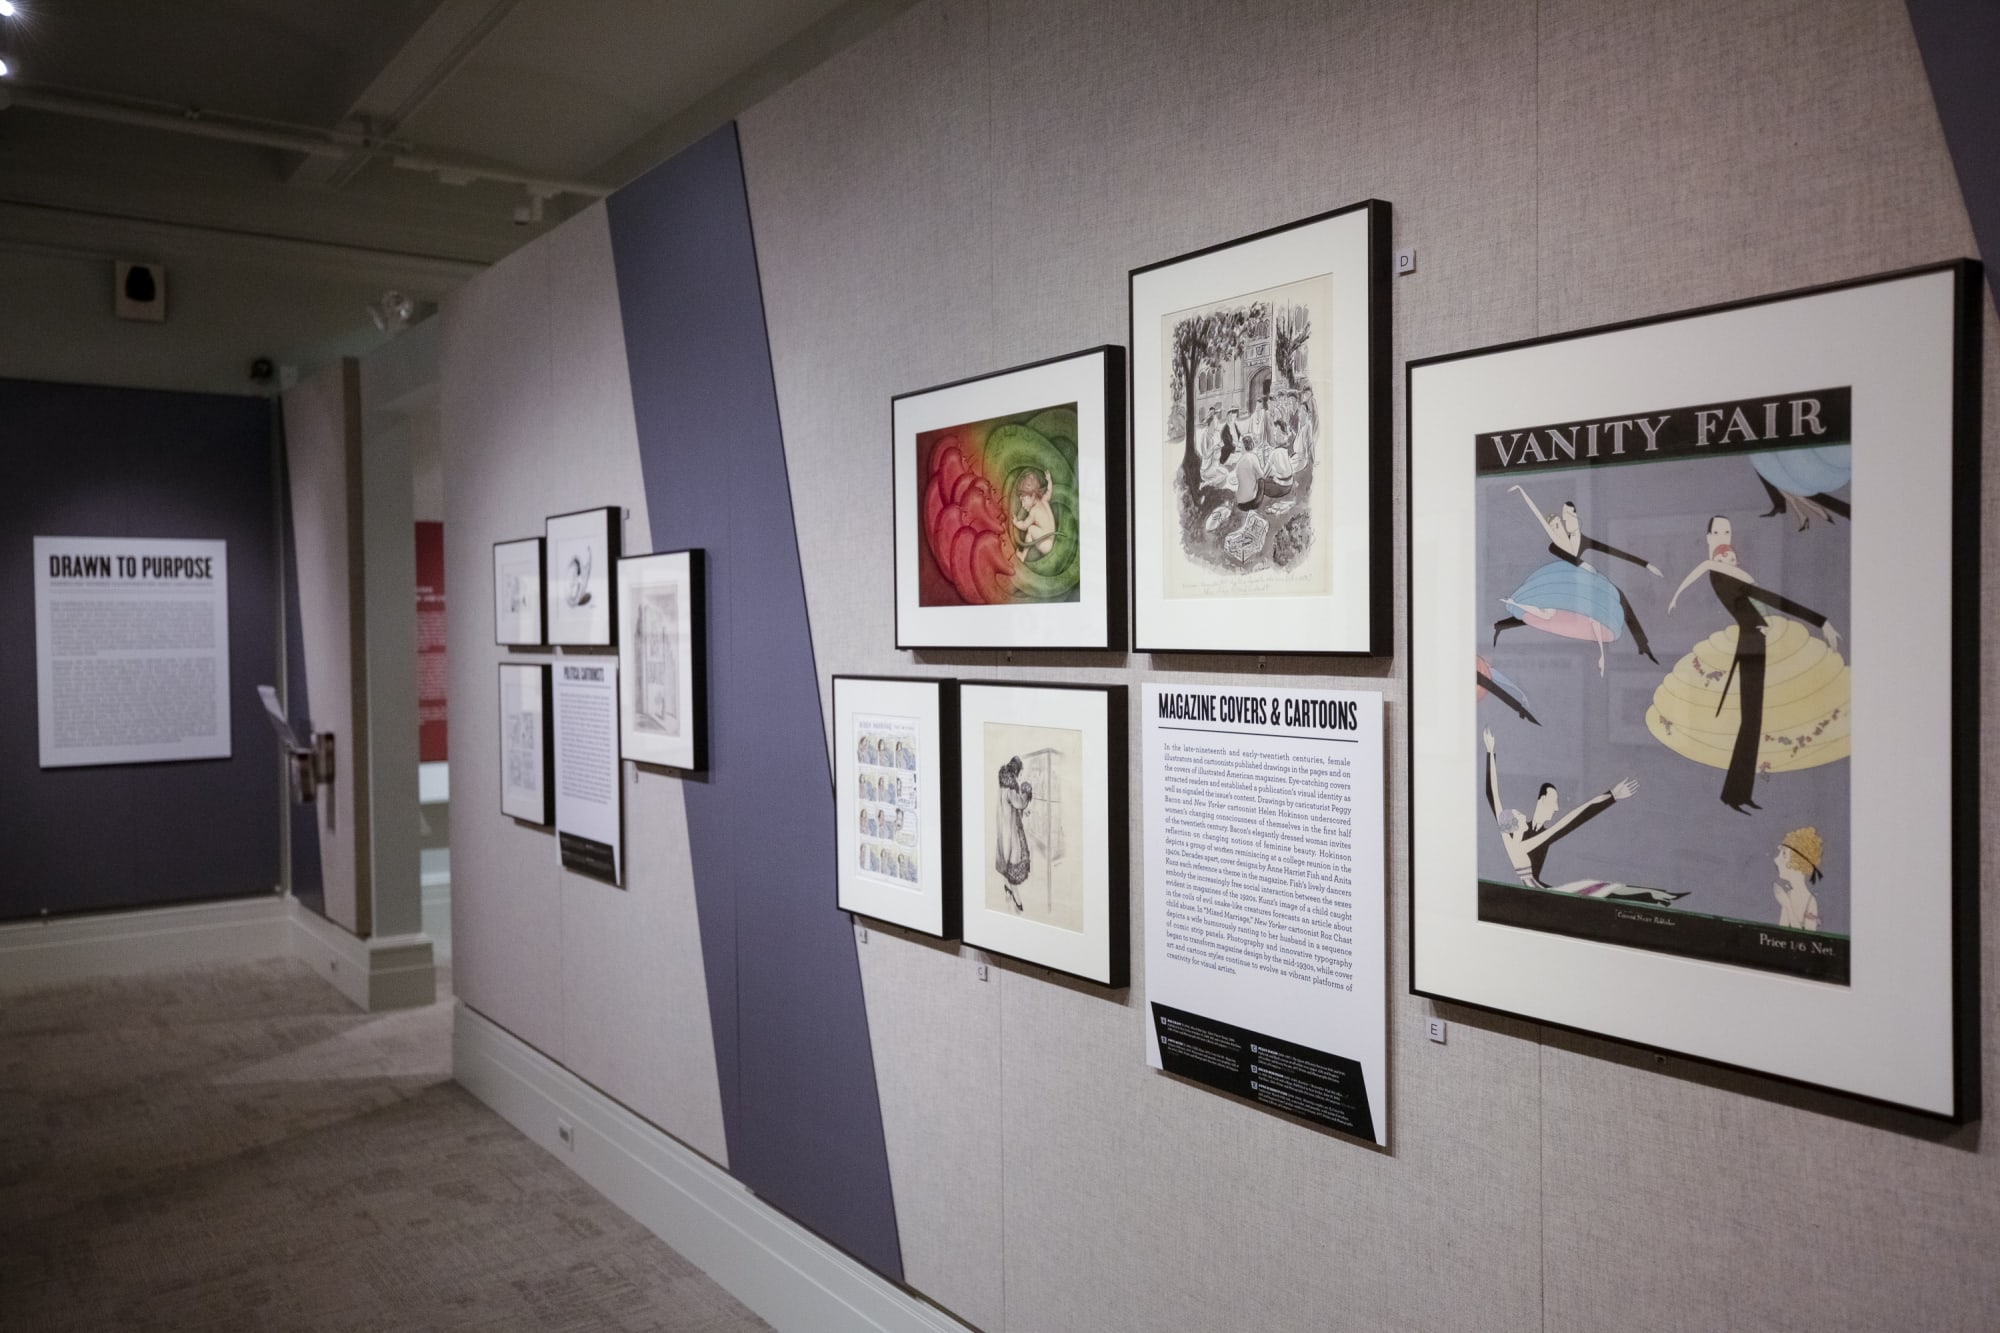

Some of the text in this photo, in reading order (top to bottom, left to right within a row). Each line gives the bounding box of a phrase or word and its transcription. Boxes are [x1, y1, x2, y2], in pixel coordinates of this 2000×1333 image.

[1400, 256, 1408, 267] D
[1491, 398, 1827, 468] VANITY FAIR
[49, 555, 213, 579] DRAWN TO PURPOSE
[1158, 692, 1358, 731] MAGAZINE COVERS & CARTOONS
[1327, 756, 1350, 765] female
[1309, 769, 1328, 777] pages
[1328, 769, 1341, 777] and
[1288, 776, 1328, 789] Eye-catching
[1297, 789, 1316, 797] visual
[1317, 791, 1342, 802] identity
[1286, 799, 1294, 808] by
[1294, 801, 1330, 811] caricaturist
[1331, 804, 1351, 815] Peggy
[1277, 809, 1308, 820] Hokinson
[1310, 814, 1351, 825] underscored
[1310, 825, 1321, 833] the
[1323, 826, 1336, 835] first
[1338, 828, 1351, 837] half
[1280, 832, 1304, 842] dressed
[1305, 838, 1328, 846] woman
[1329, 839, 1351, 849] invites
[1319, 849, 1351, 861] Hokinson
[1282, 856, 1305, 867] college
[1306, 861, 1331, 870] reunion
[1332, 863, 1339, 871] in
[1340, 864, 1351, 873] the
[1283, 867, 1305, 877] Harriet
[1306, 870, 1320, 879] Fish
[1320, 874, 1332, 882] and
[1333, 875, 1351, 885] Anita
[1307, 882, 1325, 894] lively
[1326, 885, 1351, 897] dancers
[1294, 891, 1321, 903] between
[1321, 896, 1332, 905] the
[1333, 900, 1352, 909] sexes
[1278, 900, 1298, 911] image
[1298, 904, 1305, 912] of
[1311, 907, 1328, 916] child
[1329, 911, 1351, 921] caught
[1311, 919, 1332, 928] article
[1333, 922, 1352, 932] about
[1287, 926, 1319, 937] cartoonist
[1320, 931, 1332, 940] Roz
[1333, 933, 1352, 944] Chast
[1759, 932, 1787, 949] Price
[1790, 940, 1806, 952] 1/6
[1279, 934, 1306, 946] husband
[1307, 939, 1314, 948] in
[1321, 945, 1352, 956] sequence
[1279, 945, 1312, 959] innovative
[1314, 952, 1352, 970] typography
[1288, 970, 1311, 982] vibrant
[1312, 976, 1344, 989] platforms
[1316, 966, 1333, 975] while
[1334, 971, 1353, 980] cover
[1430, 1023, 1438, 1036] E
